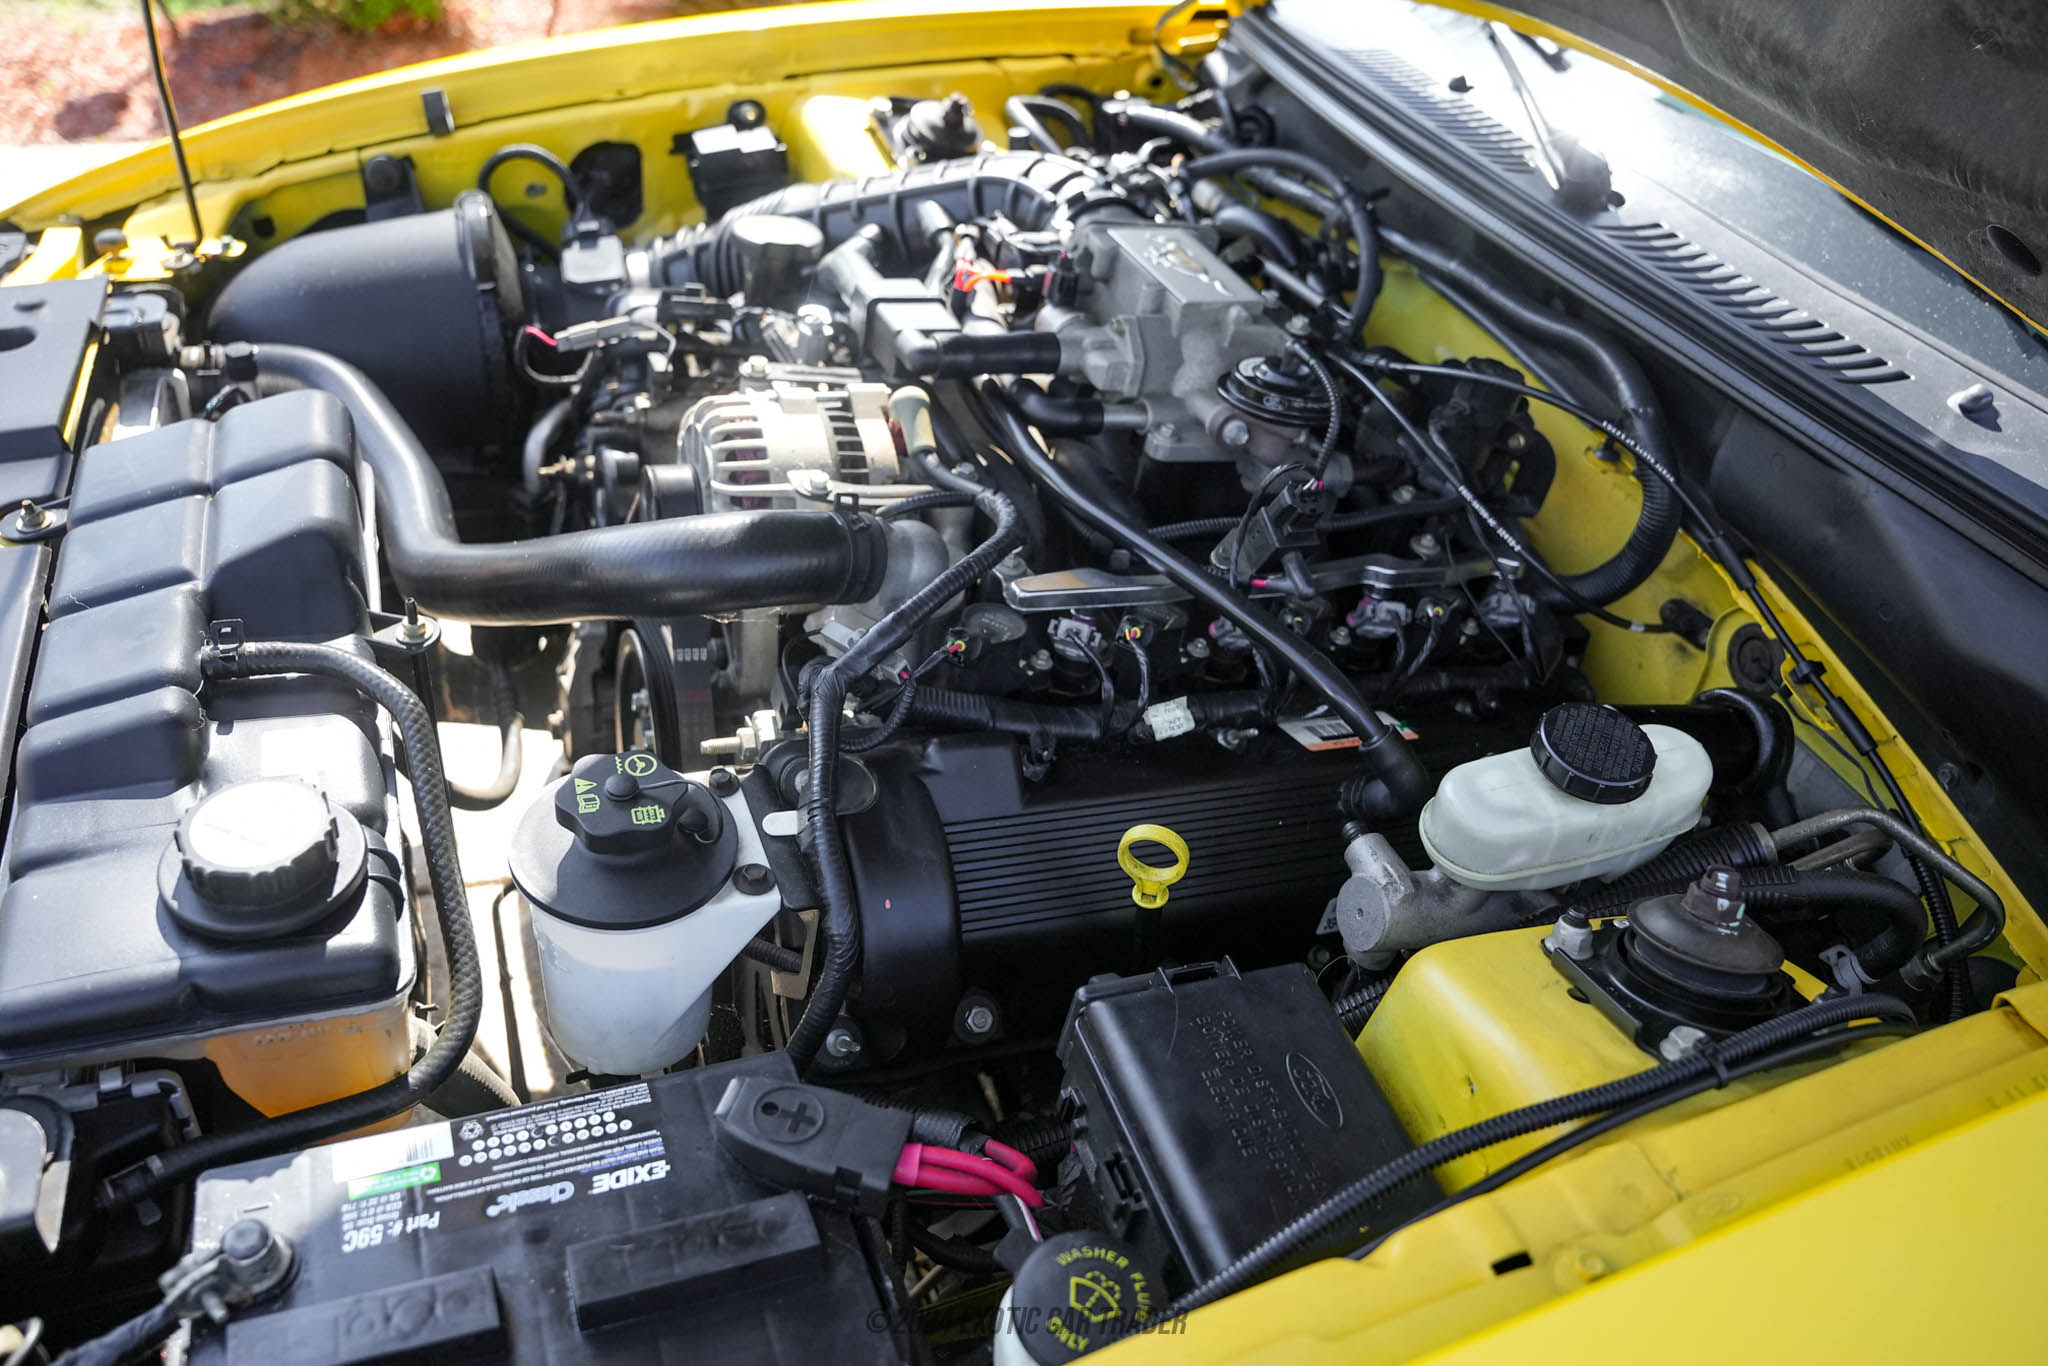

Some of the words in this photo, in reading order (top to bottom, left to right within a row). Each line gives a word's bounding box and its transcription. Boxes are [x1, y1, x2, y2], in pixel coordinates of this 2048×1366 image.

[592, 1159, 671, 1195] EXIDE
[405, 1211, 440, 1234] Part
[341, 1224, 384, 1252] 59C
[1056, 1245, 1129, 1270] WASHER
[1046, 1316, 1089, 1351] ONLY
